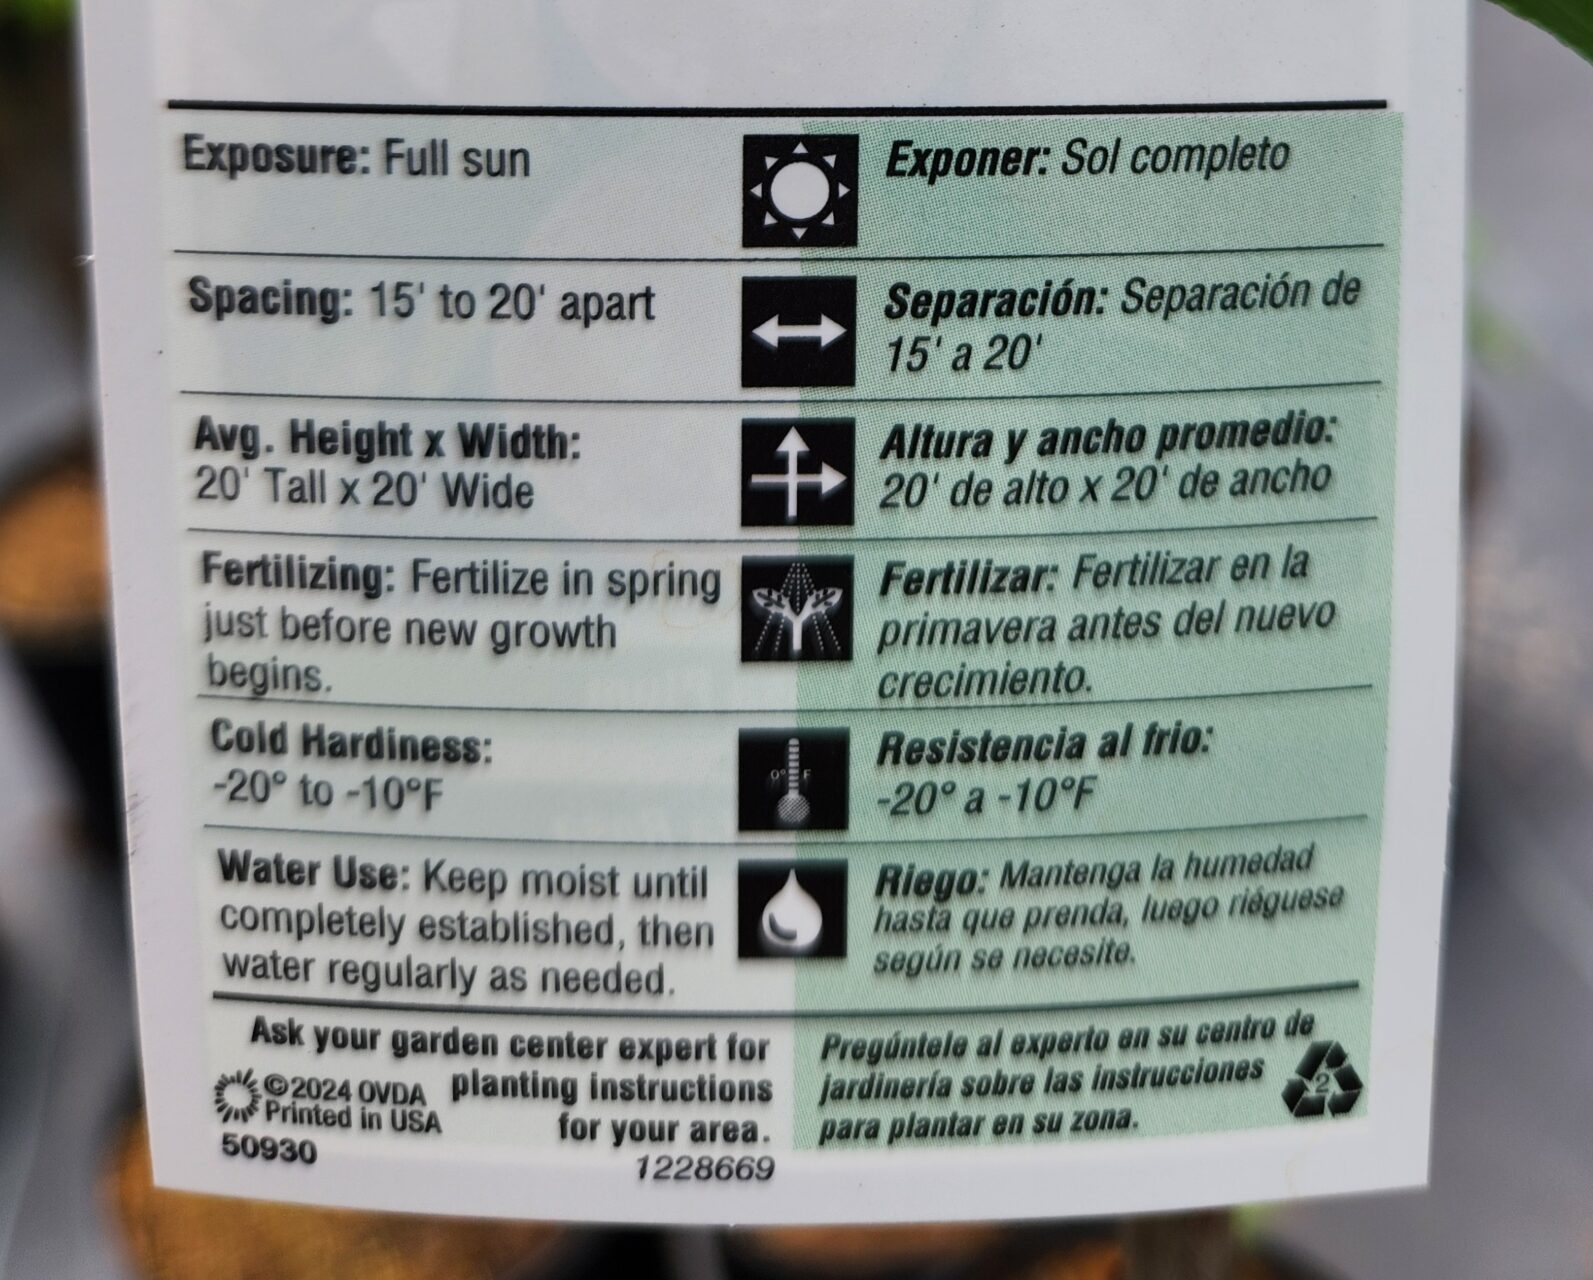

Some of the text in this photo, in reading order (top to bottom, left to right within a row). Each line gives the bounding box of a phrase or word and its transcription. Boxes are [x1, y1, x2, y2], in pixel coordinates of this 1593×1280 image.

[184, 133, 530, 179] Exposure: Full sun
[887, 136, 1290, 184] Exponer: Sol completo
[189, 276, 353, 323] Spacing:
[440, 284, 476, 318] to
[560, 285, 655, 327] apart
[885, 271, 1360, 325] Separación: Separación de
[194, 416, 580, 463] Avg. Height x Width:
[880, 411, 1336, 465] Altura y ancho promedio:
[202, 549, 720, 604] Fertilizing: Fertilize in spring
[880, 544, 1310, 597] Fertilizar: Fertilizar en la
[208, 654, 332, 695] begins.
[878, 663, 1092, 700] crecimiento.
[211, 717, 492, 763] Cold Hardiness:
[877, 720, 1212, 767] Resistencia al frio:
[219, 848, 707, 899] Water Use: Keep moist until
[251, 1017, 770, 1066] Ask your garden center expert for
[360, 1081, 426, 1106] OVDA
[452, 1068, 772, 1104] planting instructions
[819, 1058, 1264, 1104] jardinería sobre las instrucciones
[1315, 1073, 1330, 1093] 2
[265, 1101, 442, 1134] Printed in USA
[221, 1132, 318, 1164] 50930
[637, 1156, 775, 1182] 1228669
